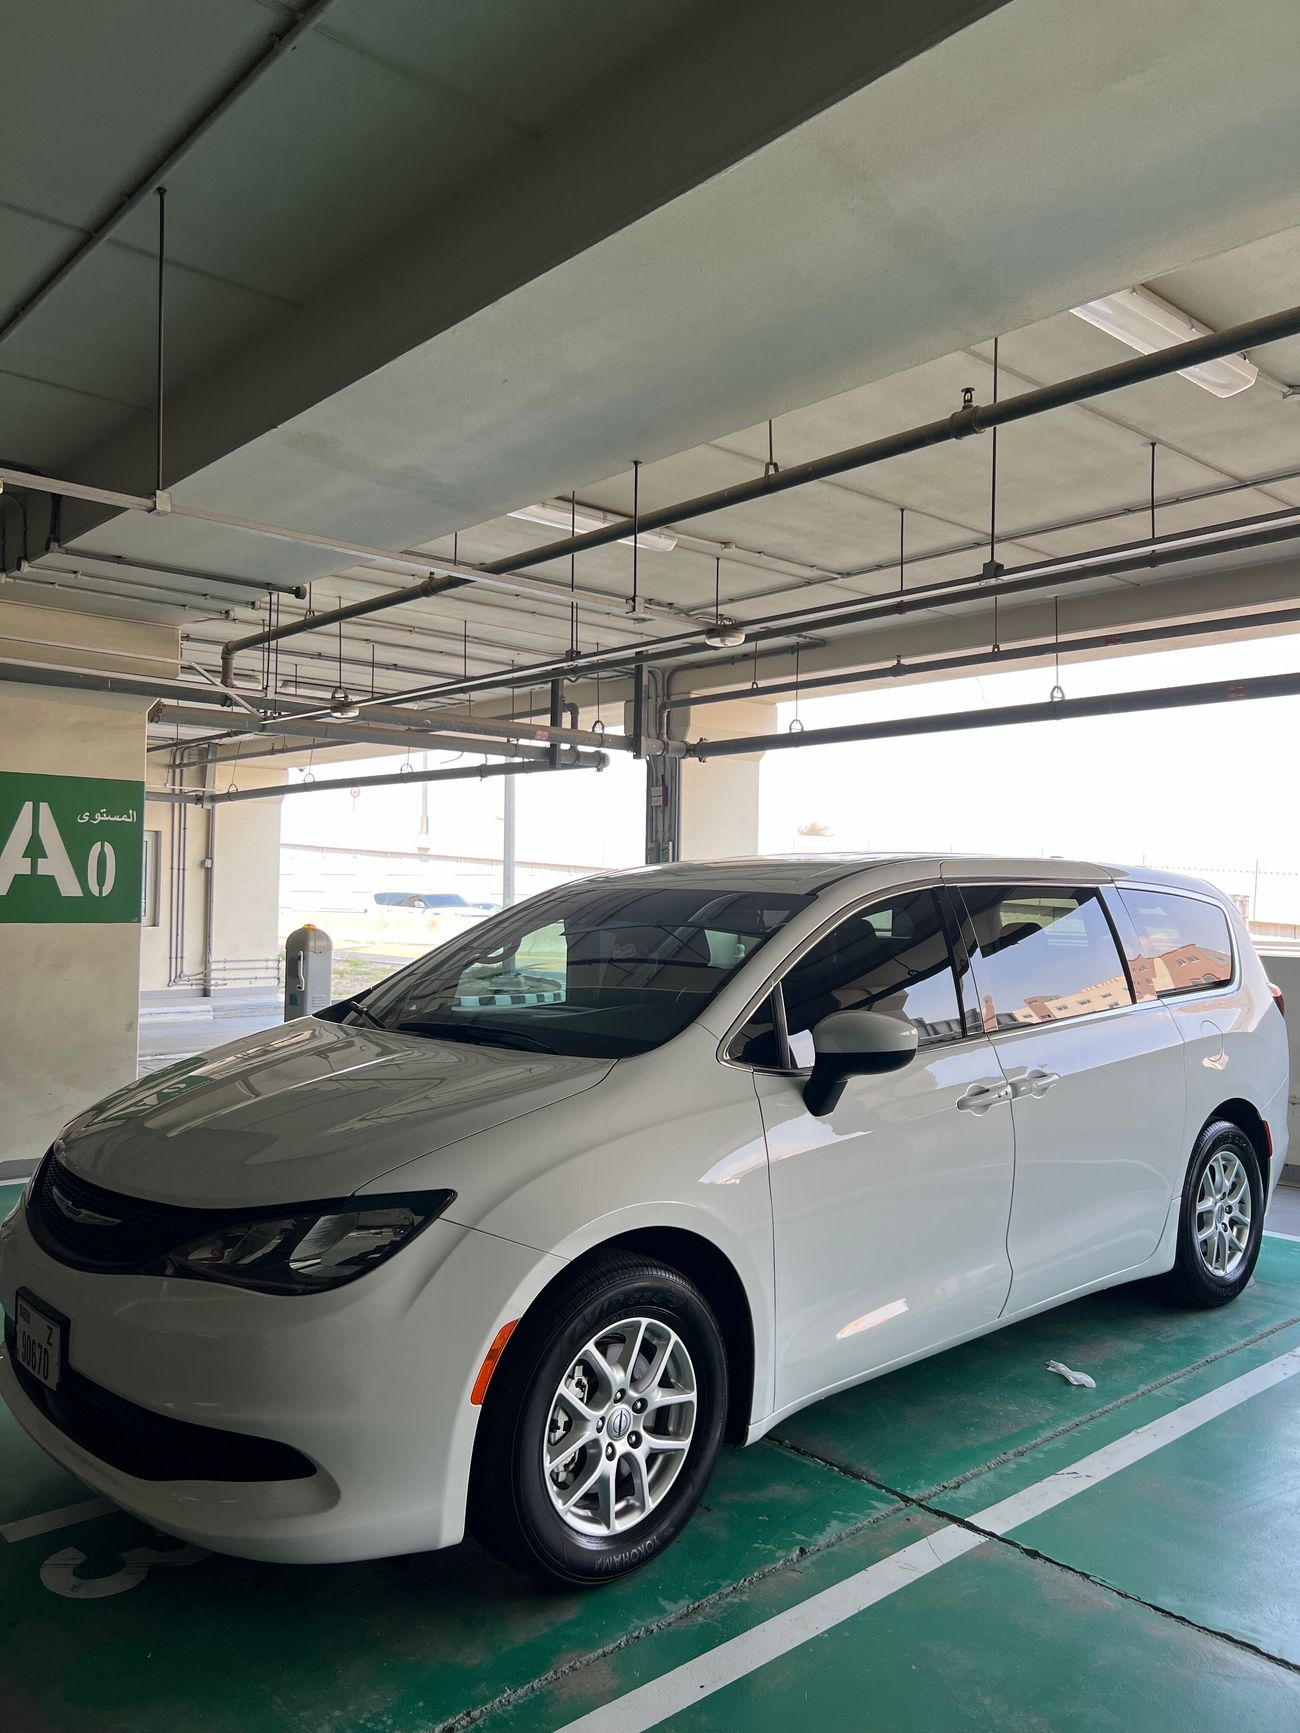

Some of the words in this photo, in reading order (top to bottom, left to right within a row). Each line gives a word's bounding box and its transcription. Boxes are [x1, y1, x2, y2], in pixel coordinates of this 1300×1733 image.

[77, 809, 136, 823] المستوى
[47, 1325, 54, 1347] Z
[22, 1330, 49, 1380] 90670
[593, 1535, 661, 1572] YOKOHAMA
